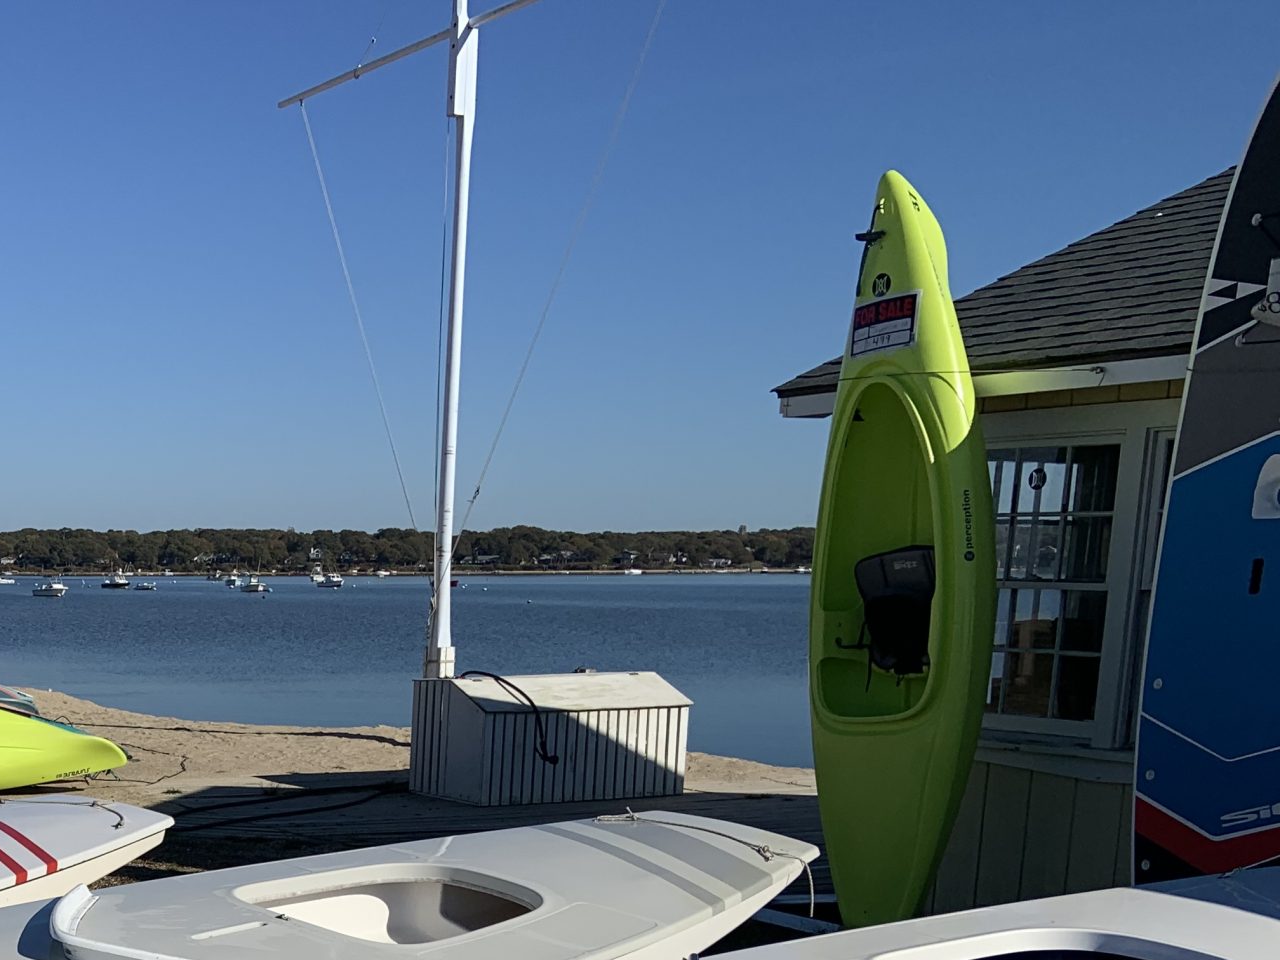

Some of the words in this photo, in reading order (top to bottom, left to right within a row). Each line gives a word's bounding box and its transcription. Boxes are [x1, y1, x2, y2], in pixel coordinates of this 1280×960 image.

[856, 305, 875, 326] FOR
[879, 297, 913, 319] SALE
[962, 489, 974, 549] perception
